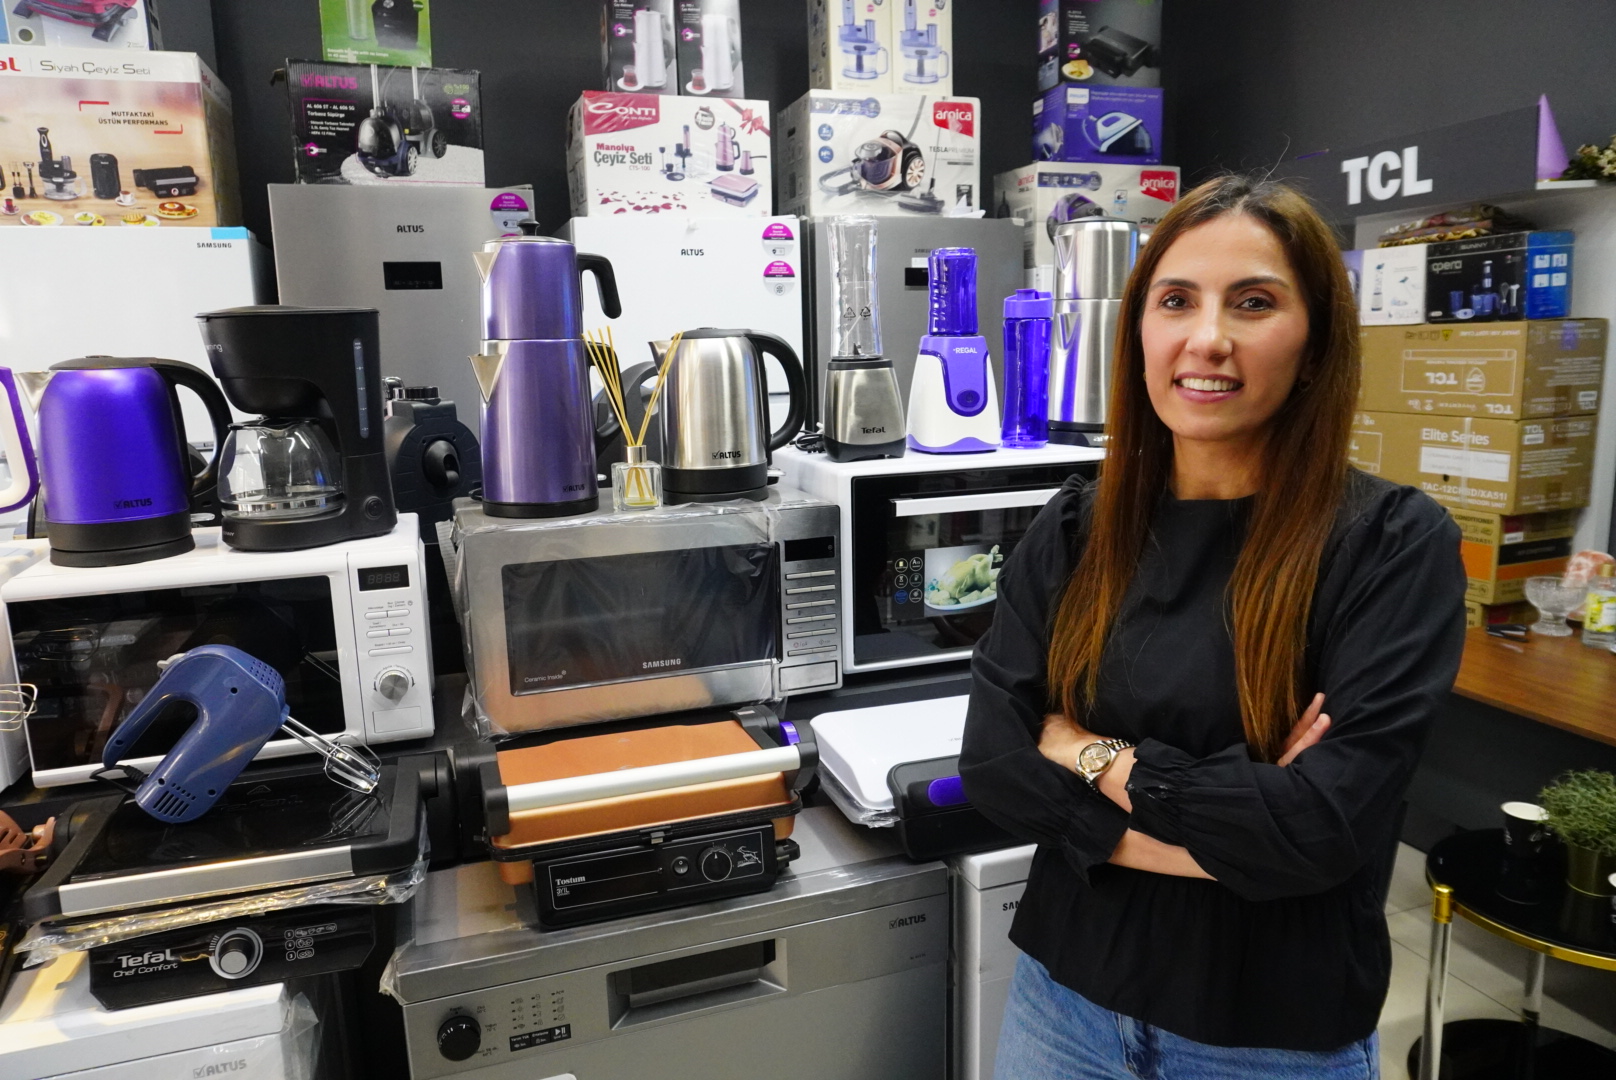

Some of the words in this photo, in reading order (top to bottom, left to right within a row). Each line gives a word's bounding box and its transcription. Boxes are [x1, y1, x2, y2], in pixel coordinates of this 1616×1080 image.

[40, 60, 79, 73] Siyah
[82, 62, 119, 75] Çeyiz
[122, 64, 150, 76] Seti
[314, 74, 358, 90] ALTUS
[588, 102, 656, 116] CONTI
[596, 142, 635, 153] Manolya
[594, 151, 626, 167] Çeyiz
[630, 152, 653, 165] Seti
[1342, 146, 1433, 206] TCL
[1142, 177, 1175, 188] arnica
[397, 225, 424, 233] ALTUS
[1425, 372, 1458, 384] TCL
[1485, 404, 1513, 414] TCL
[861, 426, 886, 435] Tefal
[1524, 424, 1544, 434] TCL
[1422, 428, 1448, 441] Elite
[1451, 430, 1489, 445] Series
[719, 451, 741, 459] ALTUS
[123, 498, 153, 509] ALTUS
[642, 658, 681, 669] SAMSUNG
[555, 876, 586, 886] Tostum
[898, 914, 926, 927] ALTUS
[118, 949, 176, 968] Tefal
[113, 969, 136, 978] Chef
[138, 962, 178, 974] Comfort
[206, 1059, 247, 1076] ALTUS
